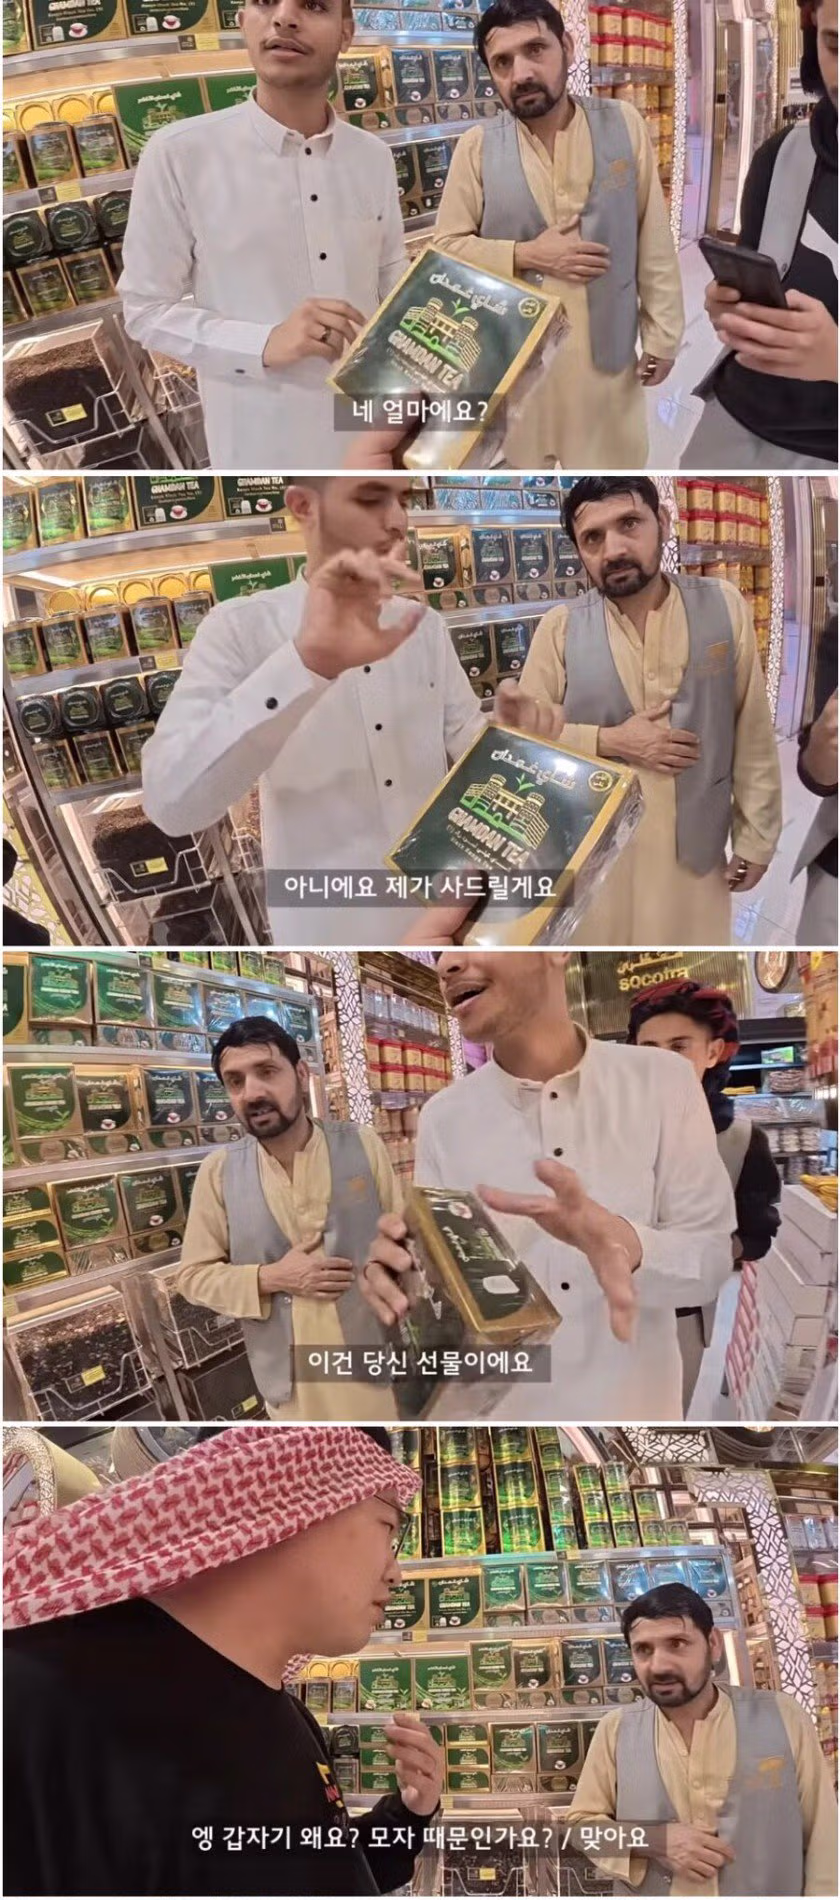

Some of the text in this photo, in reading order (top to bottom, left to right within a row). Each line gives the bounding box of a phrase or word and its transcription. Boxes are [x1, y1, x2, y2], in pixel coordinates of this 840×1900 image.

[388, 329, 443, 374] GHAMDAN
[438, 362, 465, 391] TEA
[448, 807, 504, 852] GHAMDAN
[500, 839, 531, 869] TEA
